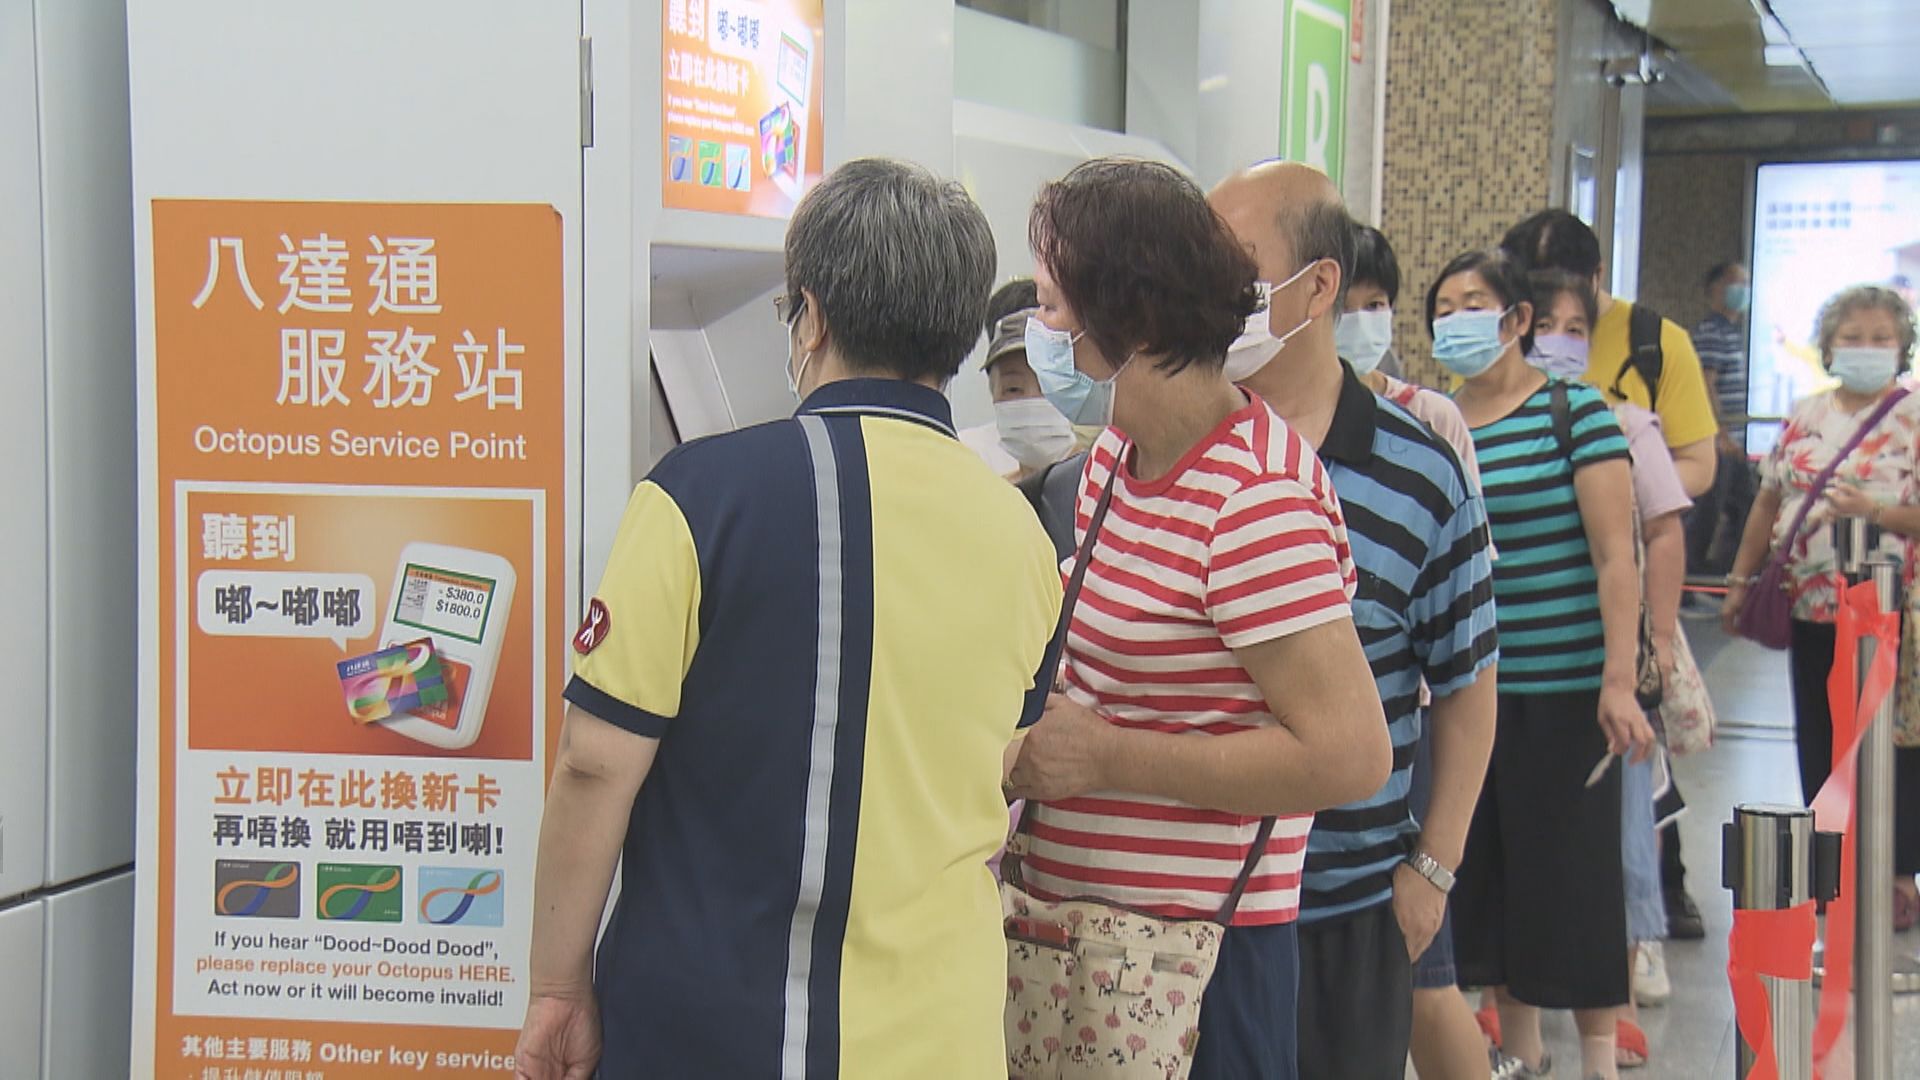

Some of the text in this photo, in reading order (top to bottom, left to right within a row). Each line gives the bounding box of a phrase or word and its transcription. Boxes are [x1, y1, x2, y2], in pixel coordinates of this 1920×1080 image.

[191, 233, 442, 316] 八達通
[276, 326, 525, 410] 服務站
[194, 425, 527, 460] Octopus Service Point
[202, 512, 296, 562] 聽到
[435, 599, 481, 620] $1800.0
[213, 764, 502, 815] 立即在此換新卡
[213, 813, 504, 856] 再唔換 就用唔到喇!
[214, 930, 226, 947] If
[231, 934, 263, 950] you
[269, 932, 309, 949] hear
[196, 954, 516, 983] please replace your Octopus HERE.
[208, 978, 504, 1006] Act now or it will become invalid!
[182, 1034, 312, 1062] 其他主要服務
[319, 1042, 383, 1064] Other
[389, 1045, 429, 1070] key
